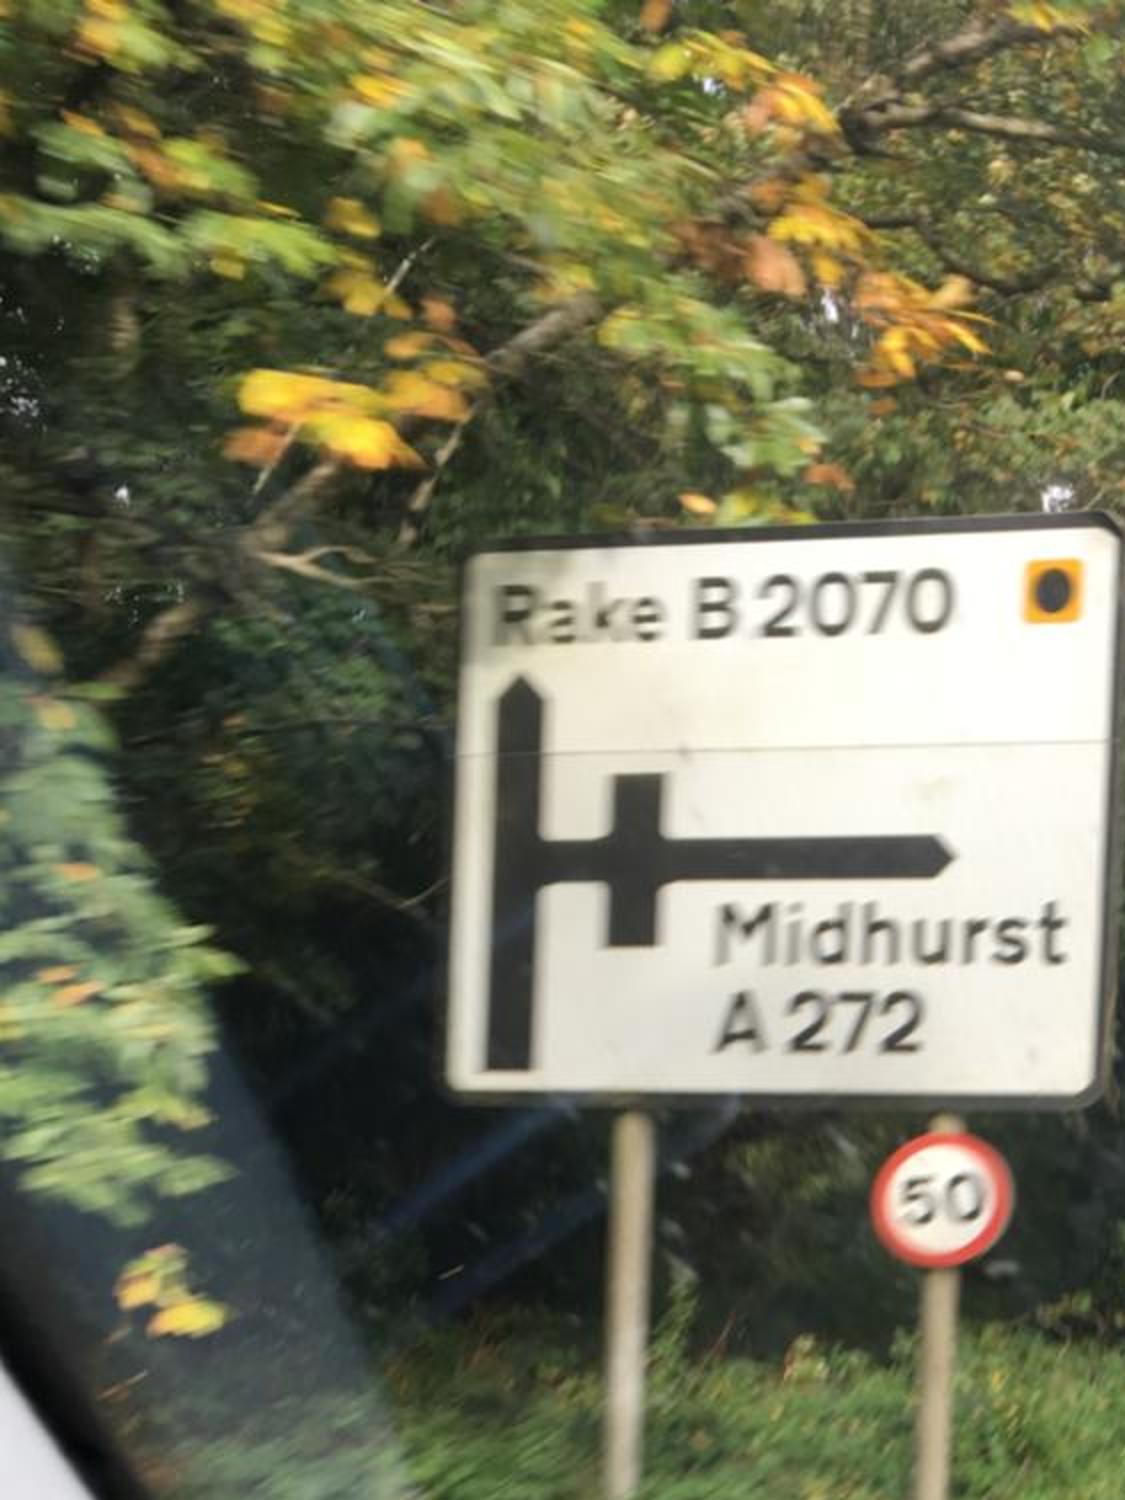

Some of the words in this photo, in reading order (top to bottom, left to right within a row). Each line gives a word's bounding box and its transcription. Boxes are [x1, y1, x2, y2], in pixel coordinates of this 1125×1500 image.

[495, 583, 665, 645] Rake
[713, 901, 1068, 966] Midhurst
[901, 1172, 984, 1227] 50
